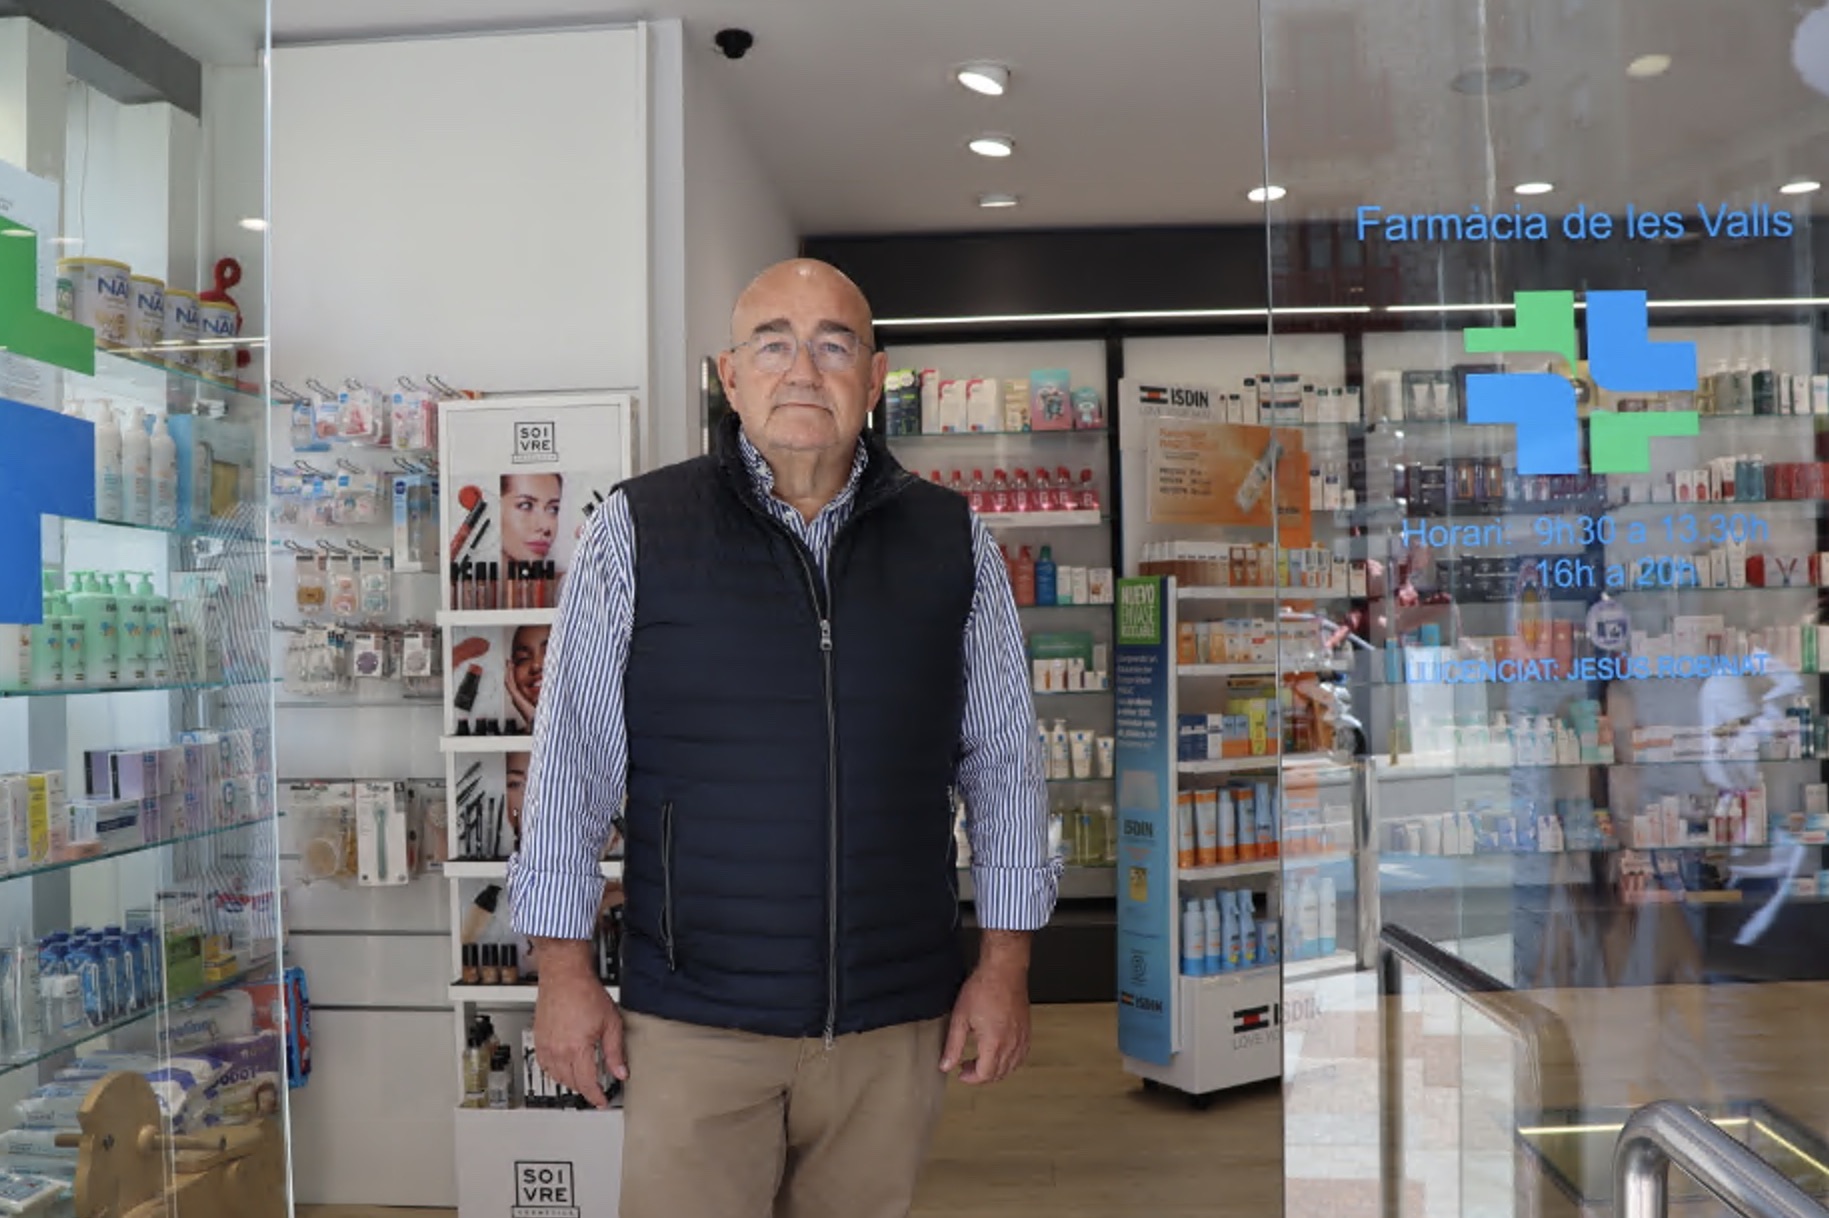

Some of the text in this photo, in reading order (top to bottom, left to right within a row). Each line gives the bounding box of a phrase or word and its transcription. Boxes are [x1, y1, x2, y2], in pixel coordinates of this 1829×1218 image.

[1356, 202, 1794, 241] Farmàcia de les Valls
[1170, 387, 1209, 408] ISDIN
[1533, 514, 1616, 546] 9h30
[1627, 520, 1647, 545] a
[1662, 512, 1769, 544] 13.30h
[1535, 555, 1698, 589] 16h a 20h
[1566, 651, 1650, 681] JESÚS
[523, 1169, 564, 1184] SOI
[523, 1186, 568, 1202] VRE
